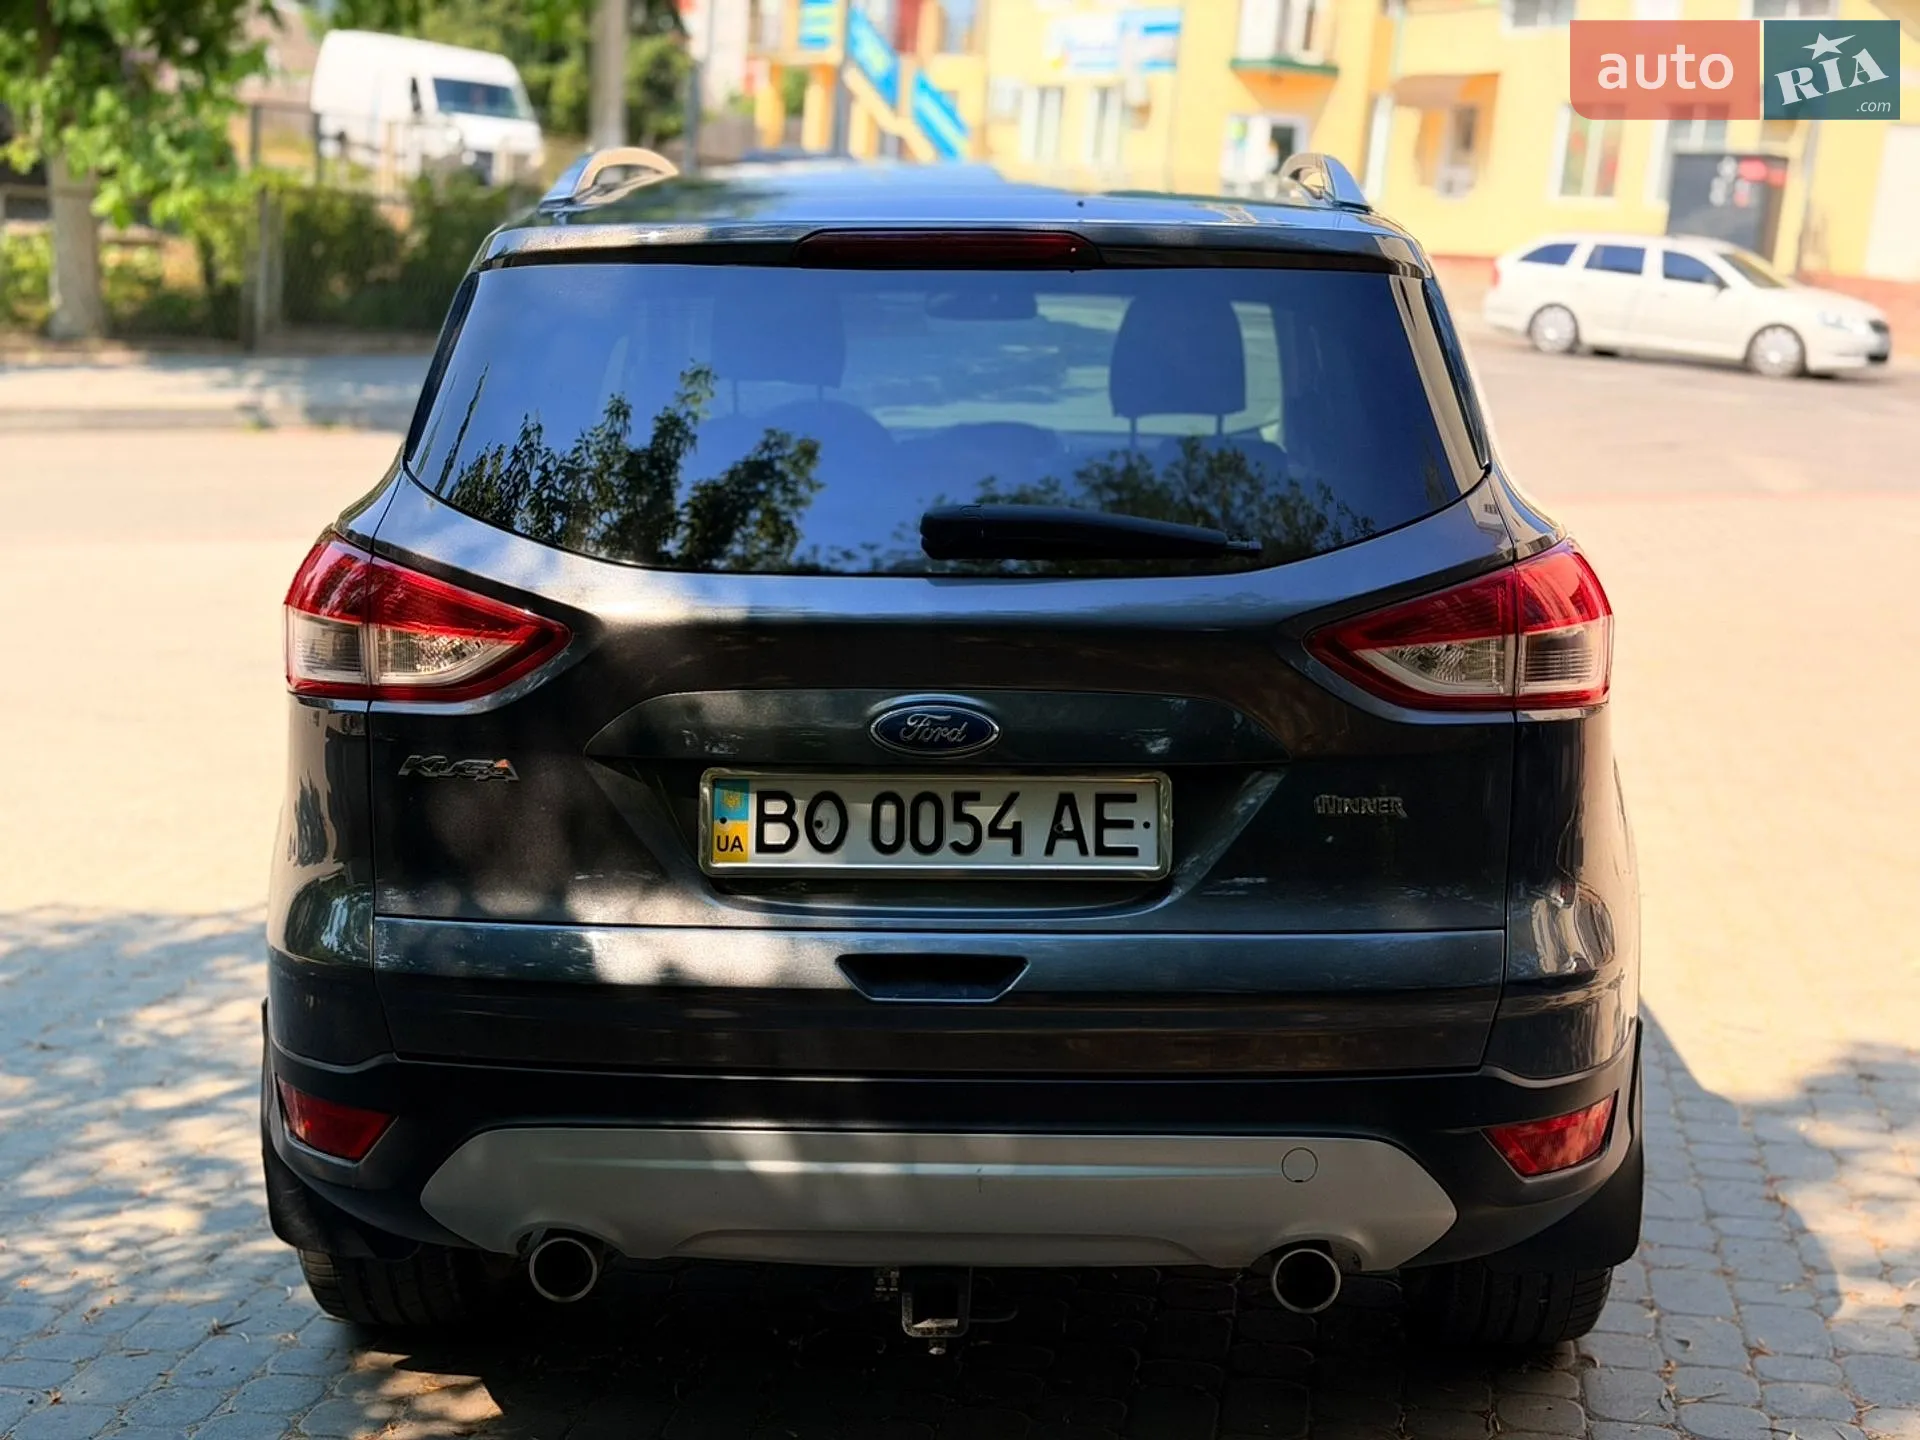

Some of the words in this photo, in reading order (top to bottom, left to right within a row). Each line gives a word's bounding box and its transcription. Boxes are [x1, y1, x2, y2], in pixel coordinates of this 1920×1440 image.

[900, 713, 968, 742] Ford
[871, 791, 1023, 856] 0054
[1044, 792, 1140, 857] AE
[716, 836, 744, 853] UA
